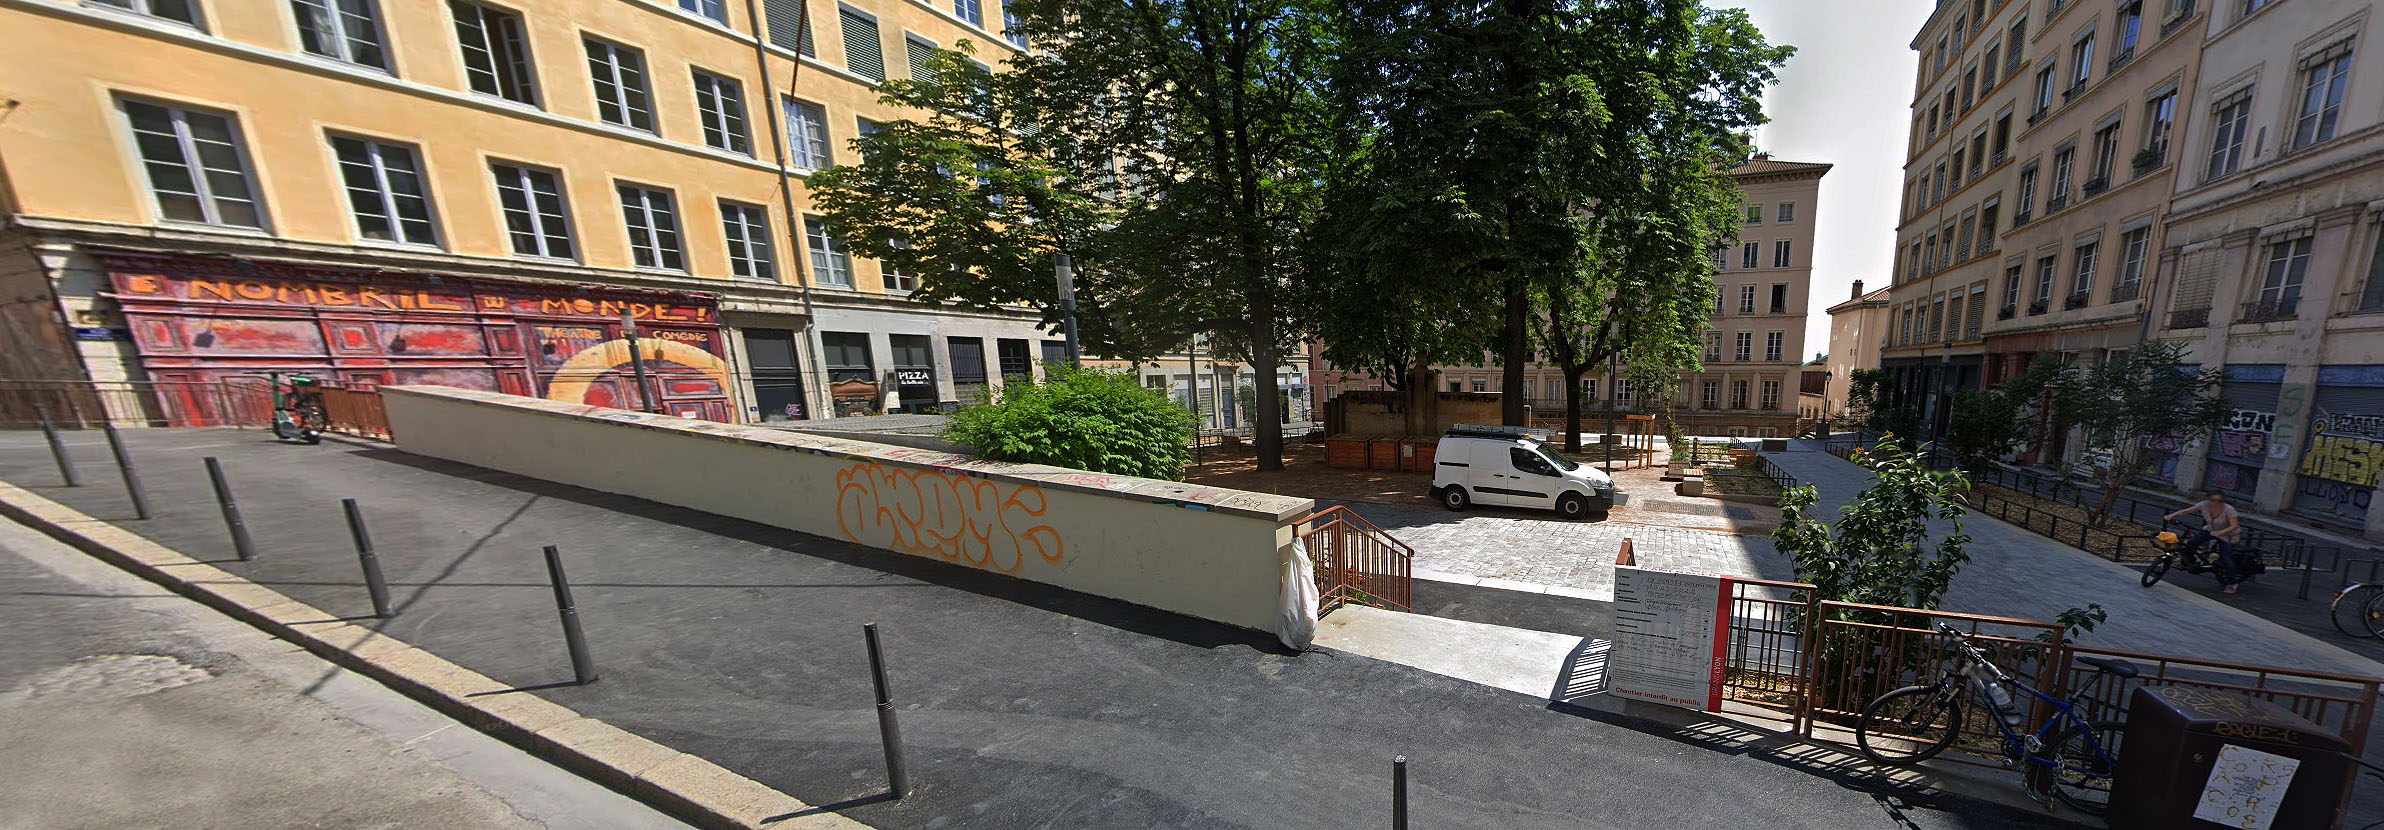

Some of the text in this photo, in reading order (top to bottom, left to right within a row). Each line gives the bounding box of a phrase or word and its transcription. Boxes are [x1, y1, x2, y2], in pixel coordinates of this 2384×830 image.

[188, 279, 464, 311] NOMBRIL
[541, 299, 688, 321] MONDE
[898, 371, 929, 380] PIZZA
[1615, 687, 1642, 697] Chantier
[1644, 691, 1669, 701] interdit
[1680, 697, 1700, 706] public
